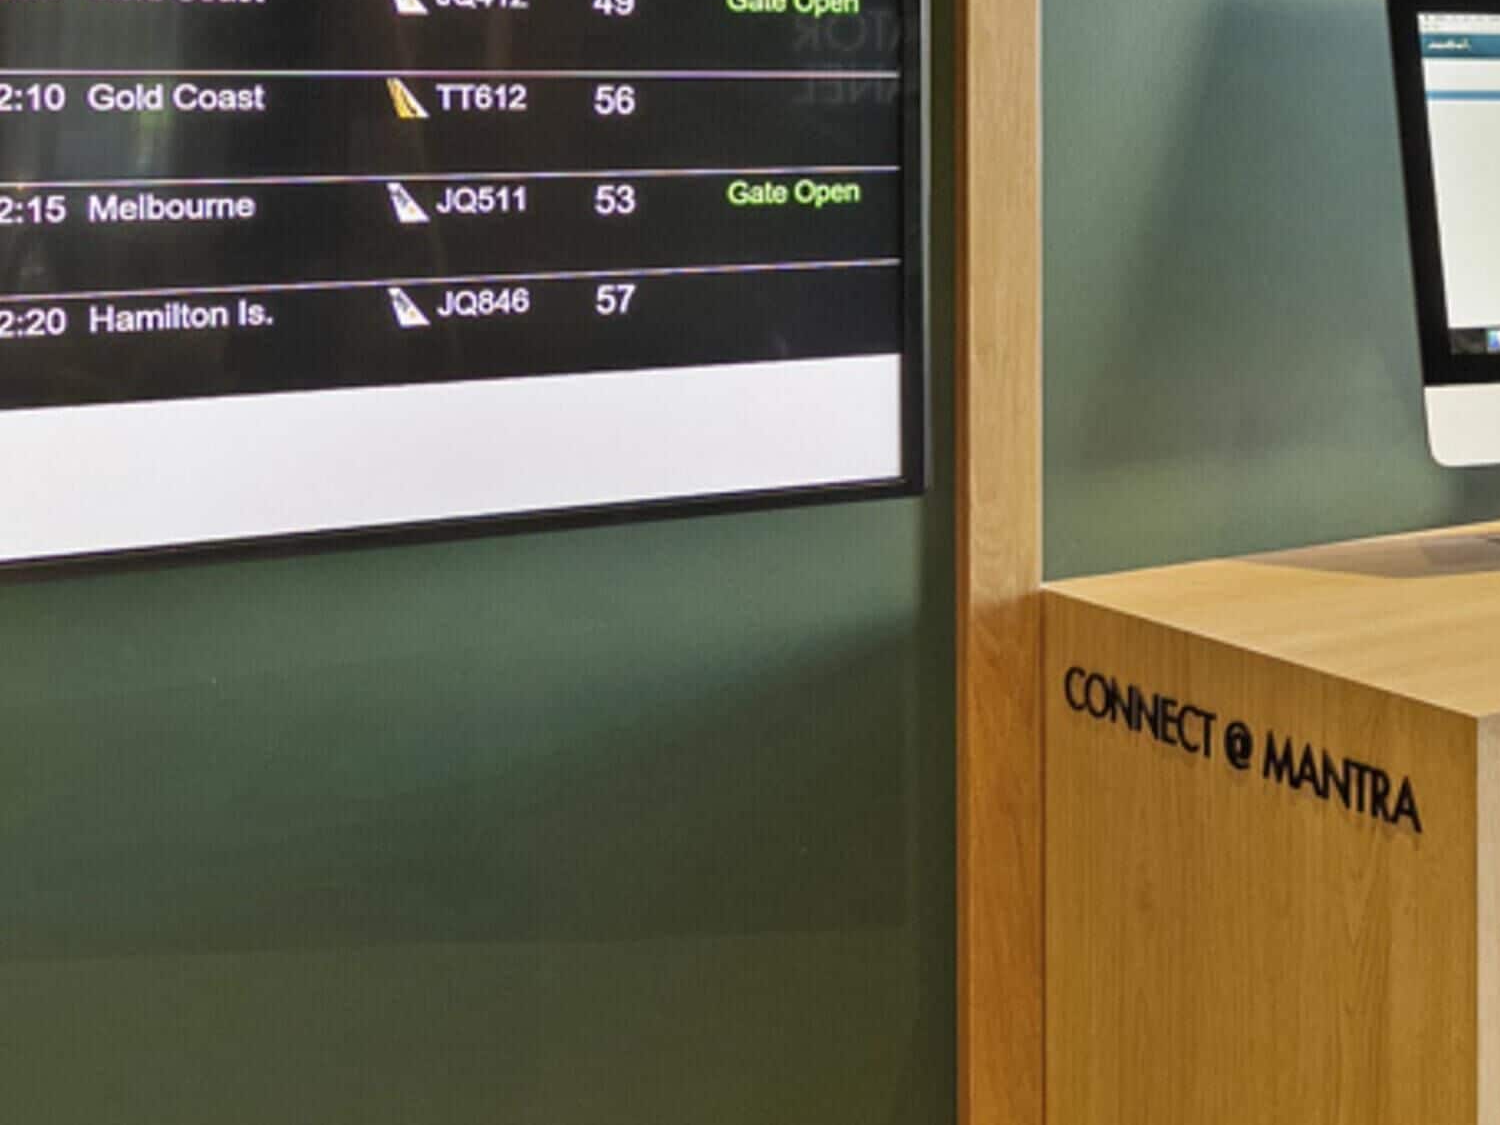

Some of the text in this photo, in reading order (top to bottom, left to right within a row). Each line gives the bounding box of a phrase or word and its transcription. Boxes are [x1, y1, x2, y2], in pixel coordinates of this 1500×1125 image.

[87, 82, 265, 111] Gold Coast
[435, 83, 527, 110] TT612
[594, 85, 636, 115] 56
[87, 193, 256, 223] Melbourne
[435, 186, 526, 214] JQ511
[595, 184, 636, 215] 53
[727, 178, 861, 208] Gate Open
[436, 287, 530, 317] JQ846
[596, 283, 636, 315] 57
[89, 298, 273, 333] Hamilton Is.
[1063, 666, 1423, 834] CONNECT @ MANTRA
